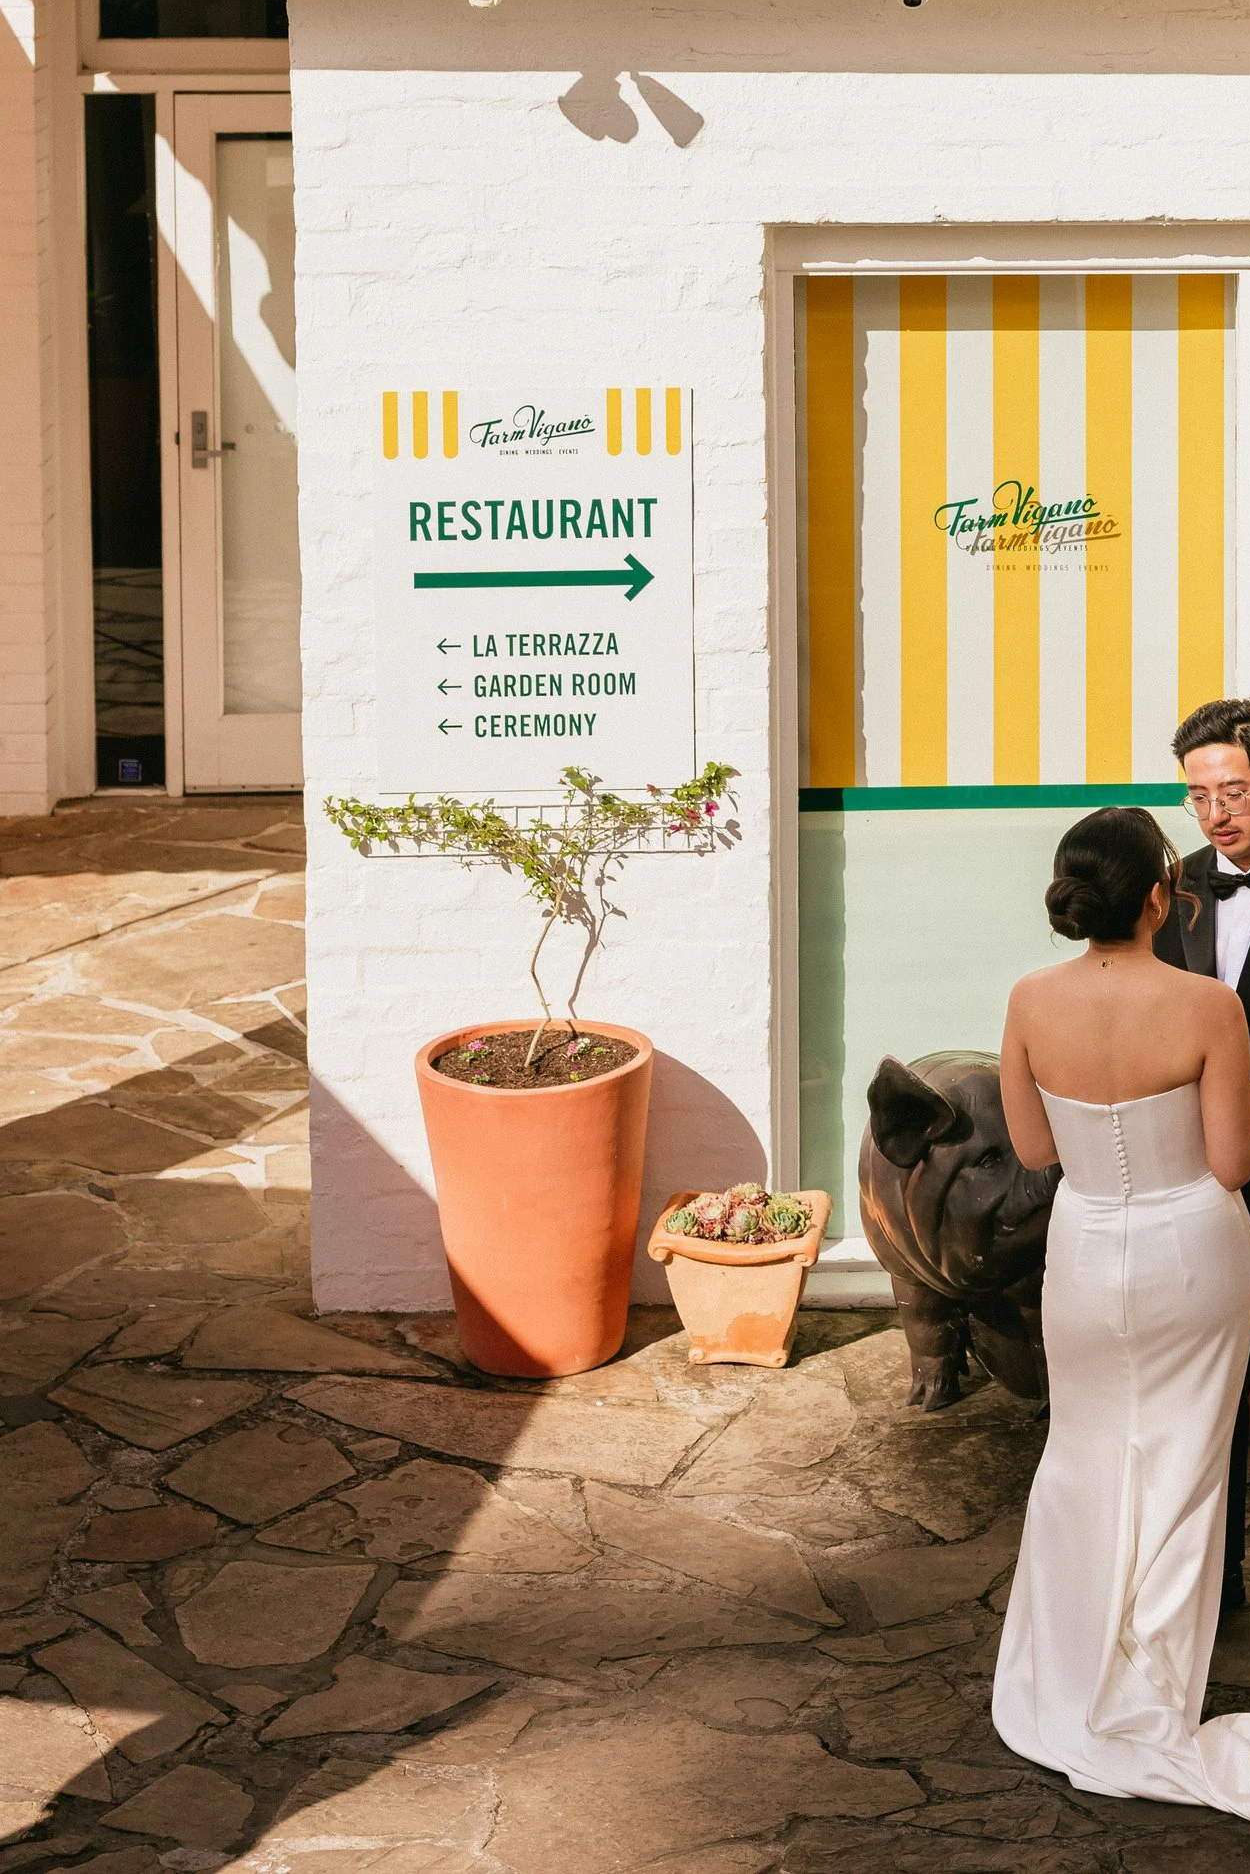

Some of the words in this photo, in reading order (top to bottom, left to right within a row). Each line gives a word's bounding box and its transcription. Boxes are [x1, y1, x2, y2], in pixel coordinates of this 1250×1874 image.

[470, 418, 526, 447] Farm
[410, 498, 657, 542] RESTAURANT
[934, 497, 1007, 536] Farm
[1005, 544, 1050, 552] WEDDINGS
[1058, 544, 1088, 552] EVENTS
[473, 634, 498, 658] LA
[505, 632, 619, 657] TERRAZZA
[474, 674, 562, 698] GARDEN
[572, 672, 636, 696] ROOM
[474, 713, 597, 738] CEREMONY
